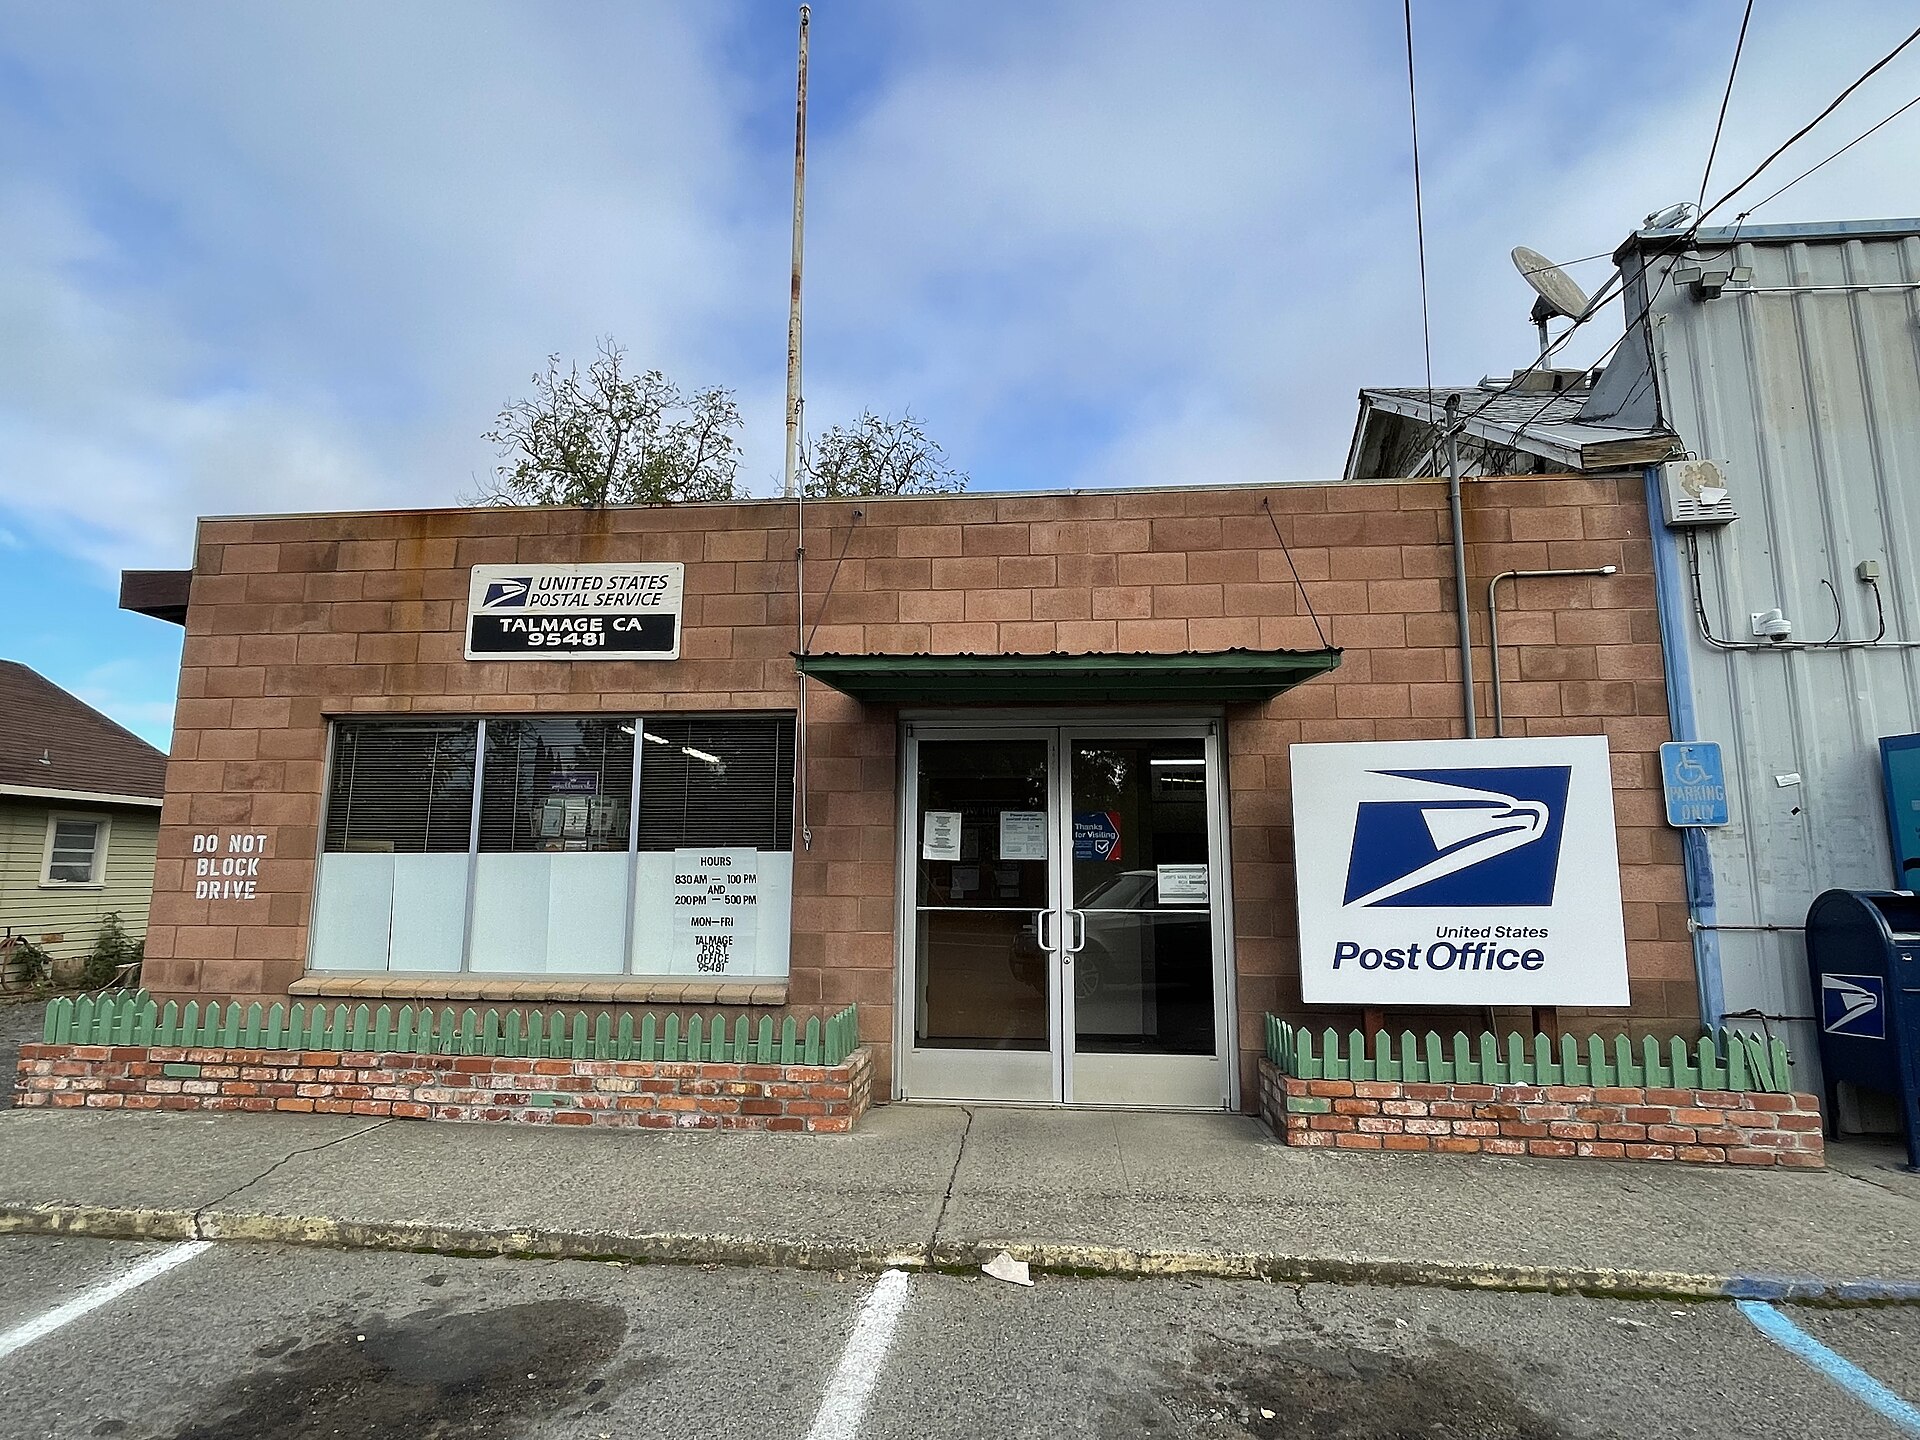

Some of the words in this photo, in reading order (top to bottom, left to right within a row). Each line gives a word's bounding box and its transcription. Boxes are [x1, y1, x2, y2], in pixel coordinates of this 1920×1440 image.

[538, 576, 602, 591] UNITED
[606, 575, 669, 590] STATES
[529, 593, 590, 607] POSTAL
[593, 592, 663, 607] SERVICE
[500, 618, 603, 633] TALMAGE
[612, 617, 643, 632] CA
[527, 632, 605, 646] 95481
[1669, 785, 1724, 801] PARKING
[1682, 804, 1715, 820] ONLY
[1087, 831, 1116, 840] Visiting
[193, 834, 219, 853] DO
[228, 834, 267, 853] NOT
[196, 857, 260, 876] BLOCK
[700, 856, 732, 866] HOURS
[726, 874, 742, 884] 100
[743, 874, 757, 884] PM
[195, 880, 257, 899] DRIVE
[707, 885, 726, 895] AND
[724, 895, 742, 904] 500
[743, 895, 757, 905] PM
[1436, 926, 1491, 939] United
[1494, 925, 1549, 938] States
[695, 935, 733, 945] TALMAGE
[702, 944, 727, 954] POST
[1332, 941, 1422, 970] Post
[1426, 941, 1545, 971] Office
[696, 953, 729, 963] OFFICE
[698, 963, 725, 973] 95481
